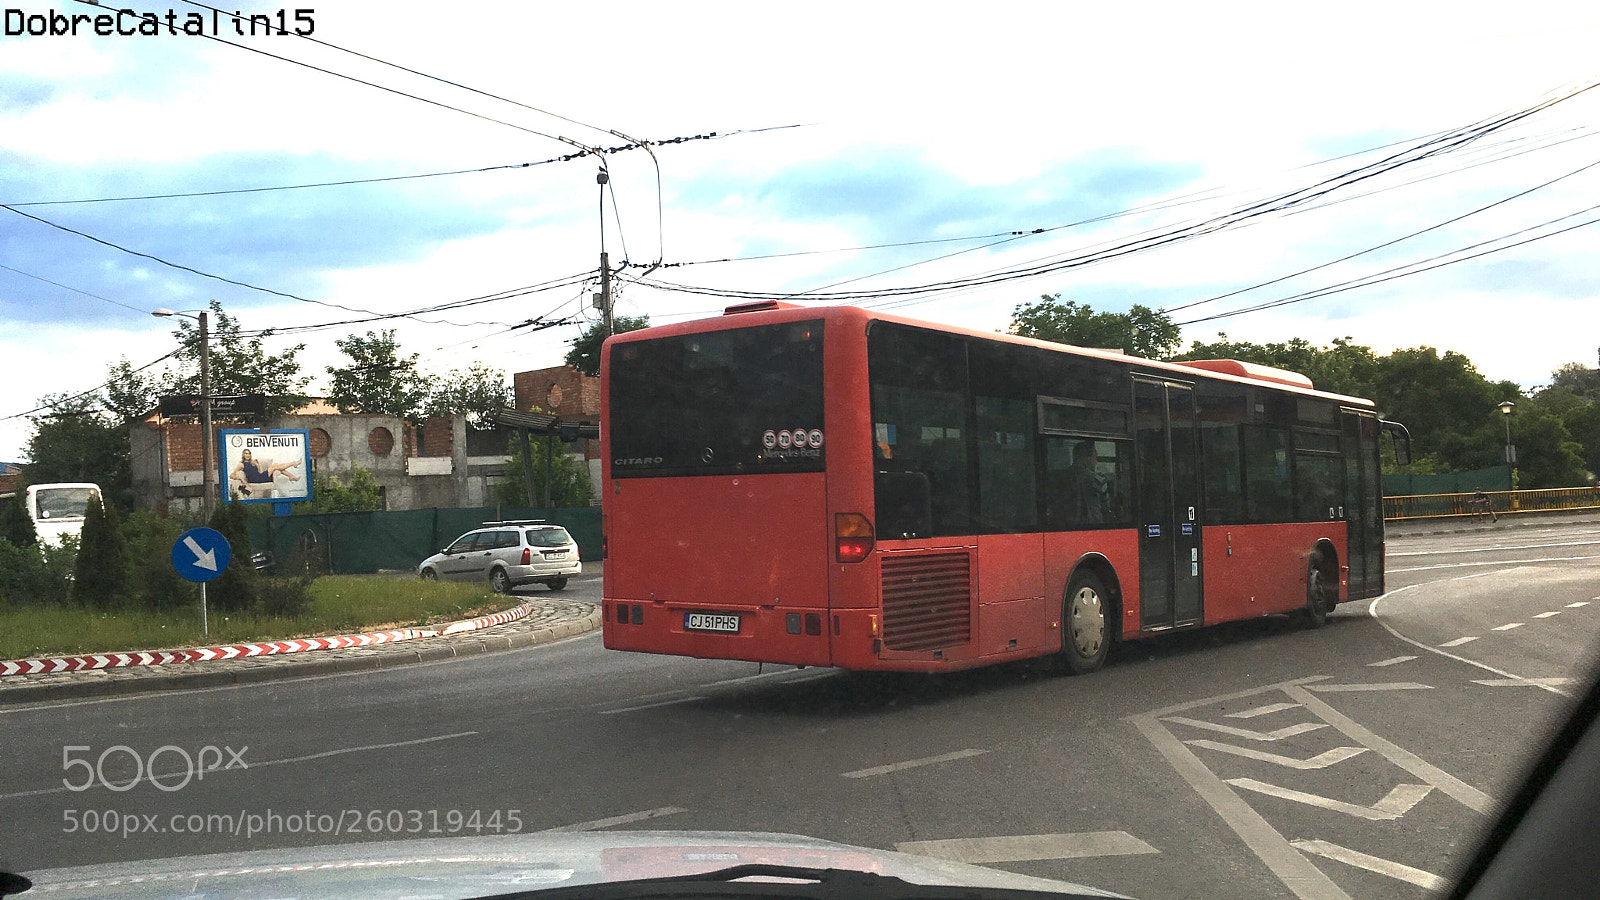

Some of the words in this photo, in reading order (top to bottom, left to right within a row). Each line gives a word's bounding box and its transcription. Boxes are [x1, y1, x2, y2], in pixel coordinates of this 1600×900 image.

[246, 435, 299, 448] BENVENUTI
[765, 434, 775, 444] 50
[780, 434, 790, 444] 70
[795, 433, 805, 442] 80
[811, 434, 821, 443] 90
[614, 456, 663, 466] CITARO
[690, 615, 703, 628] CJ
